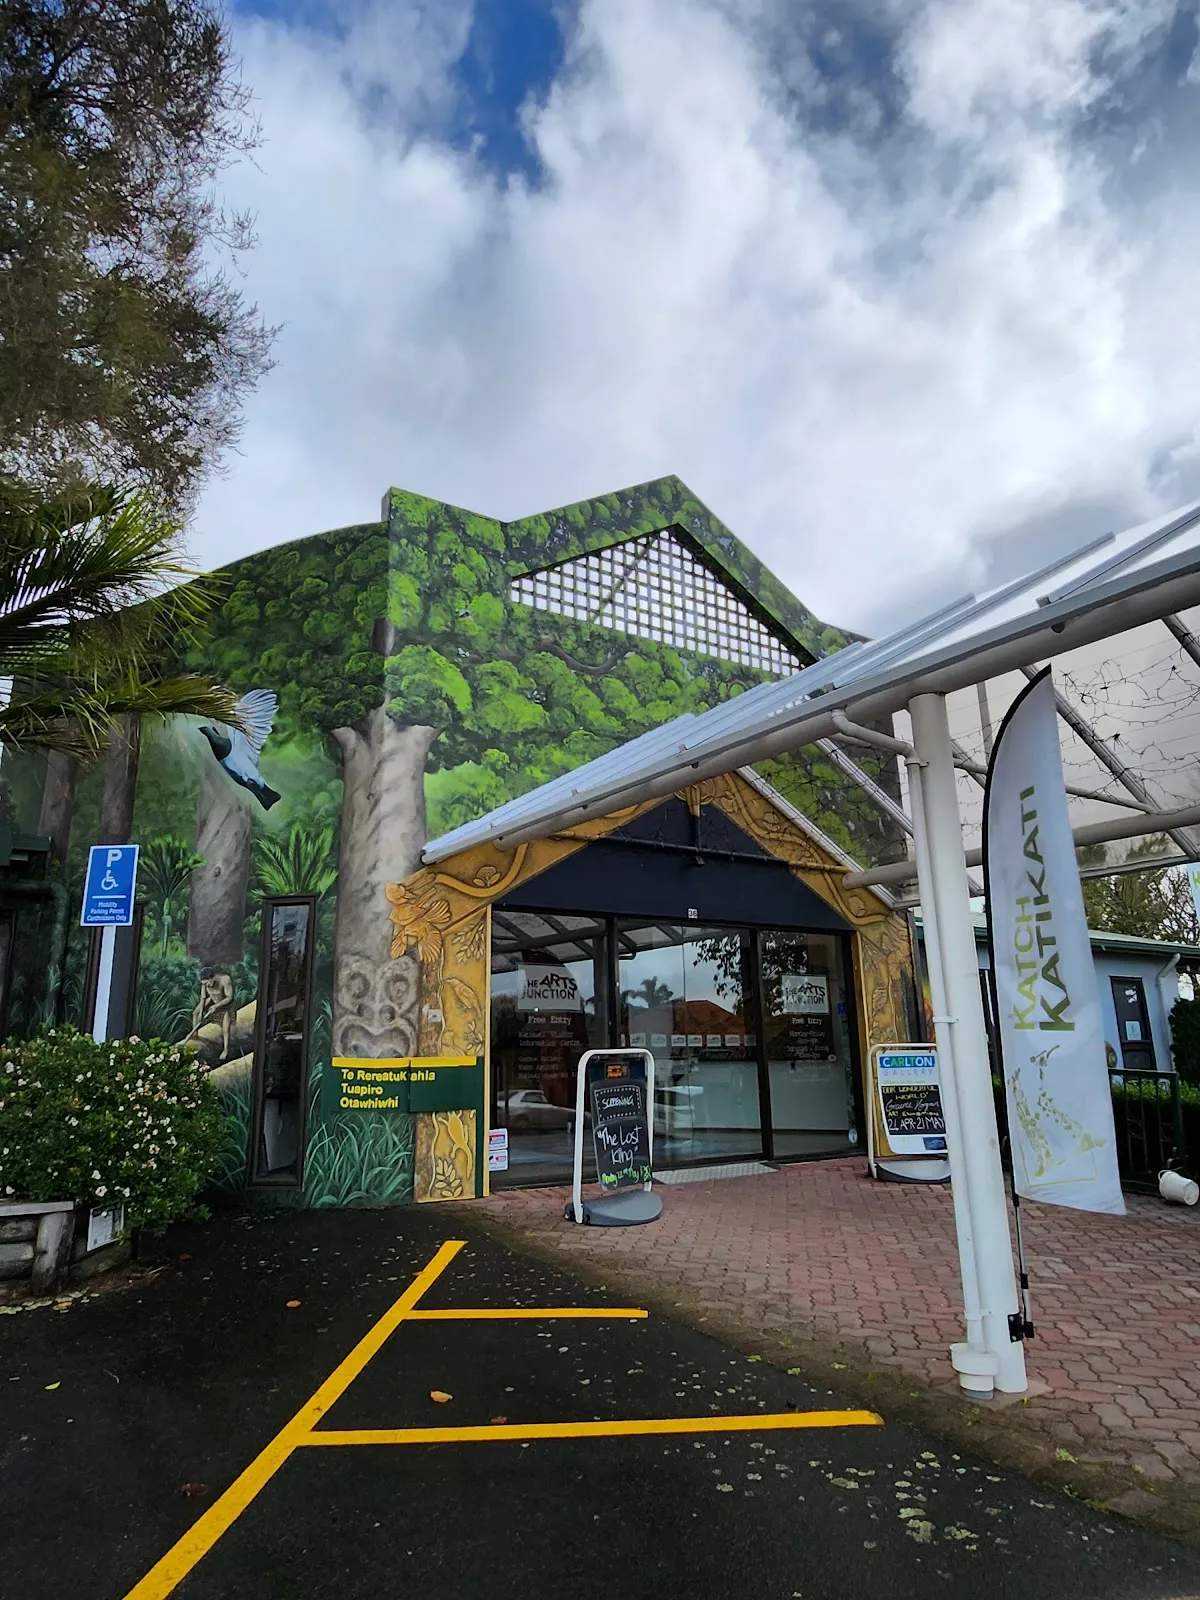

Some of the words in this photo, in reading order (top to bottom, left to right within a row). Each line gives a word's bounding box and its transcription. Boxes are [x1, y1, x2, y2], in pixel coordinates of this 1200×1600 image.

[107, 849, 122, 867] P
[1020, 785, 1075, 1031] KATIKATI
[1013, 896, 1039, 1030] KATCH
[540, 973, 578, 991] ARTS
[798, 982, 825, 996] ARTS
[528, 1016, 546, 1024] Free
[550, 1015, 571, 1025] Entry
[882, 1056, 933, 1067] CARLTON
[341, 1069, 354, 1080] Te
[341, 1083, 383, 1096] Tuapiro
[340, 1096, 398, 1109] Otawhiwhi
[925, 1116, 944, 1130] MAY
[619, 1125, 642, 1145] Lost
